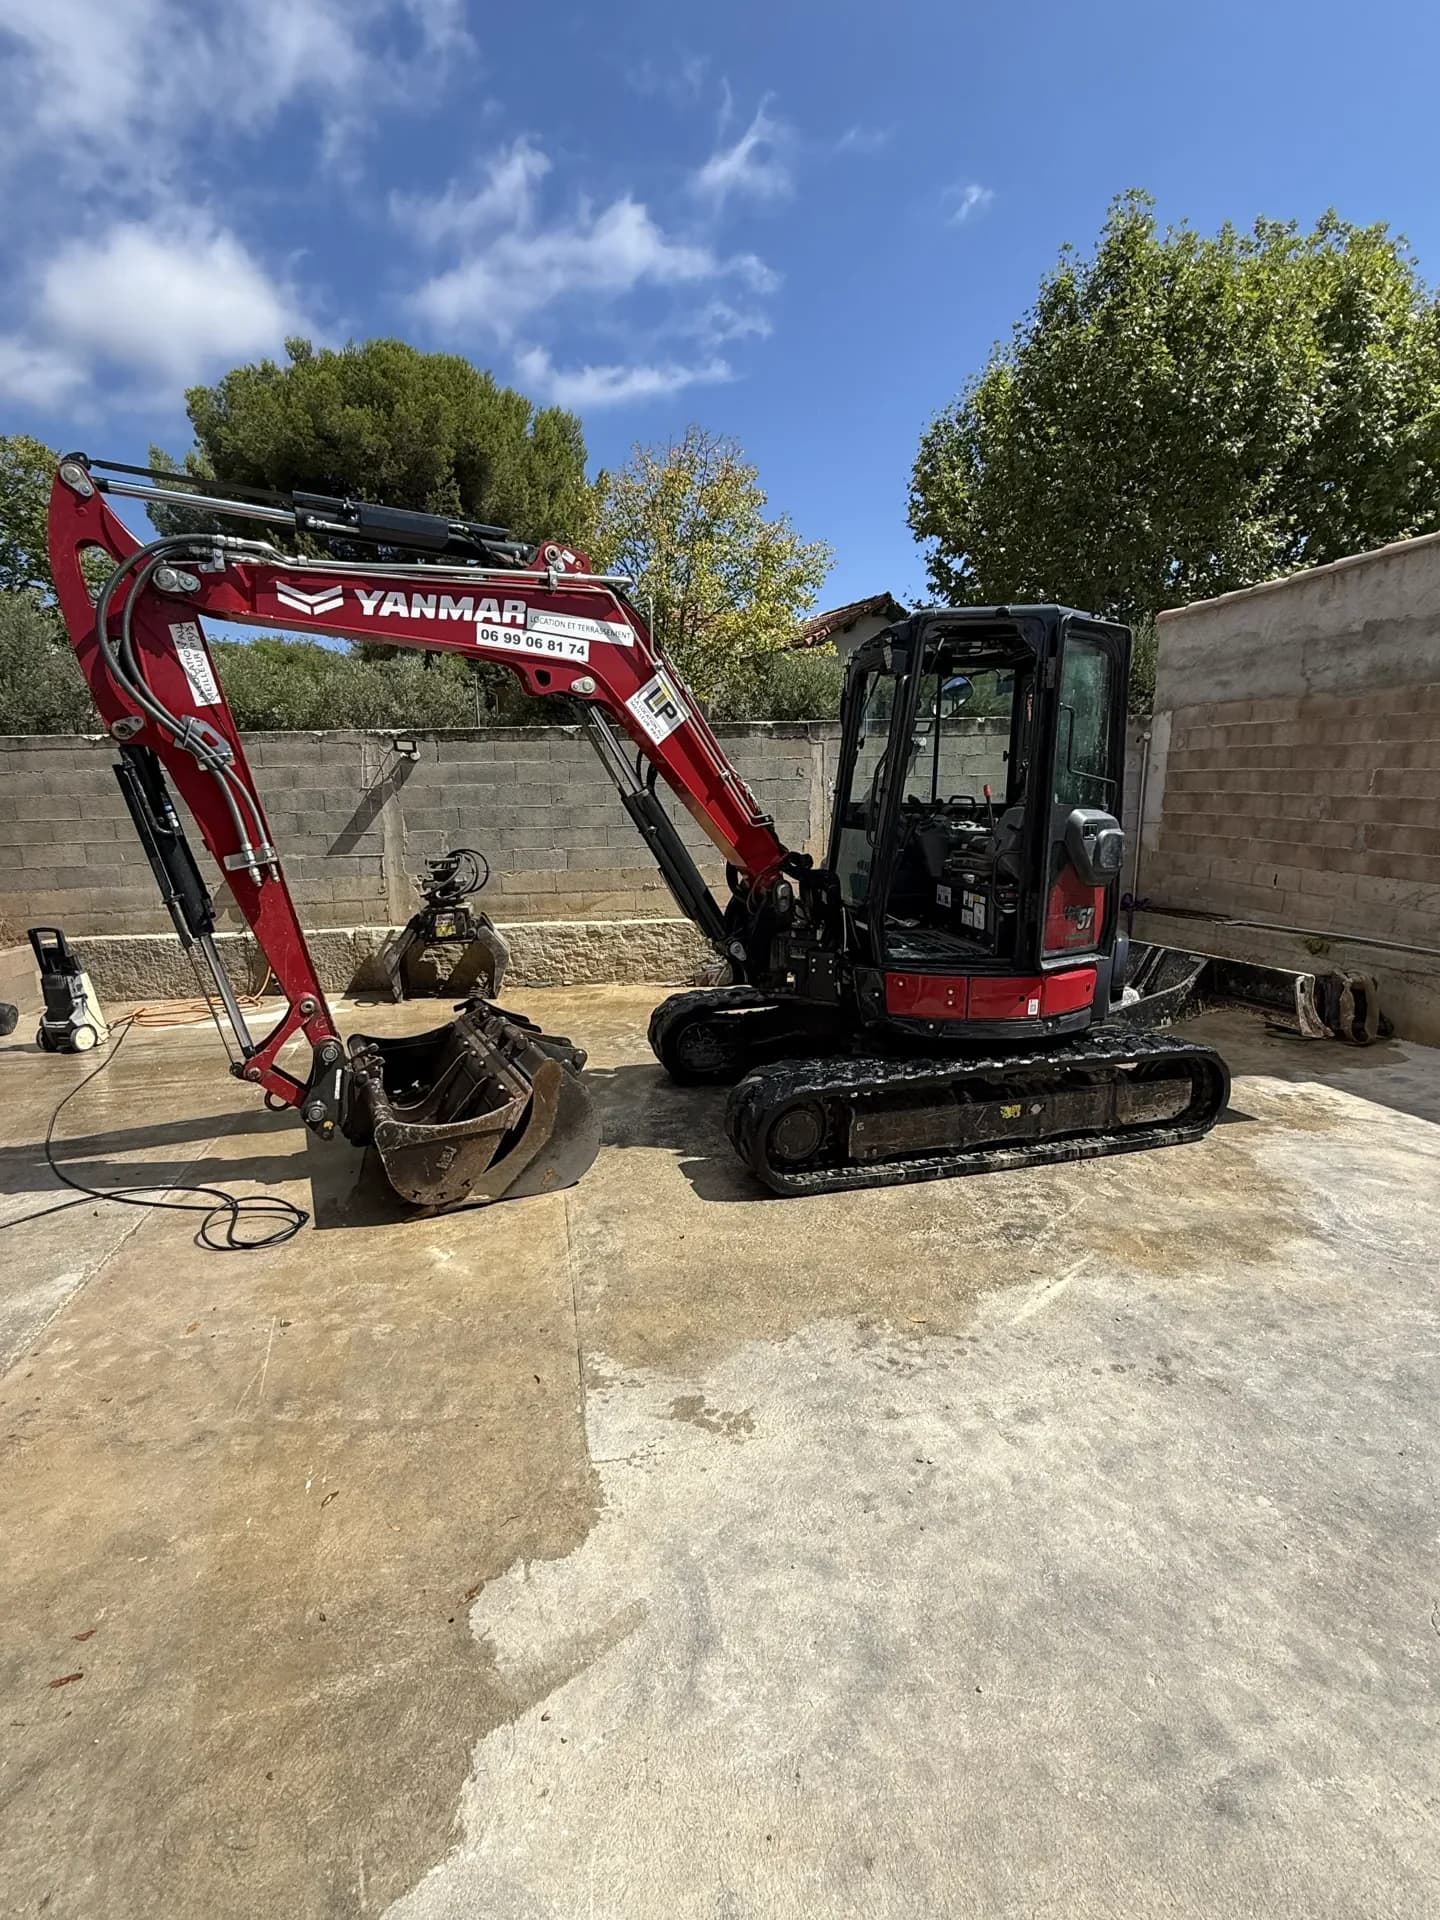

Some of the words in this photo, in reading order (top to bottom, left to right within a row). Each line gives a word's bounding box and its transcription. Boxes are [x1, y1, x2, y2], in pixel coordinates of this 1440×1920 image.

[354, 589, 527, 624] YANMAR
[530, 616, 565, 629] LOCATION
[567, 620, 576, 630] ET
[577, 623, 631, 639] TERRASSEMENT
[481, 629, 498, 642] 06
[503, 633, 521, 645] 99
[526, 636, 543, 649] 06
[547, 640, 563, 652] 81
[569, 643, 585, 656] 74
